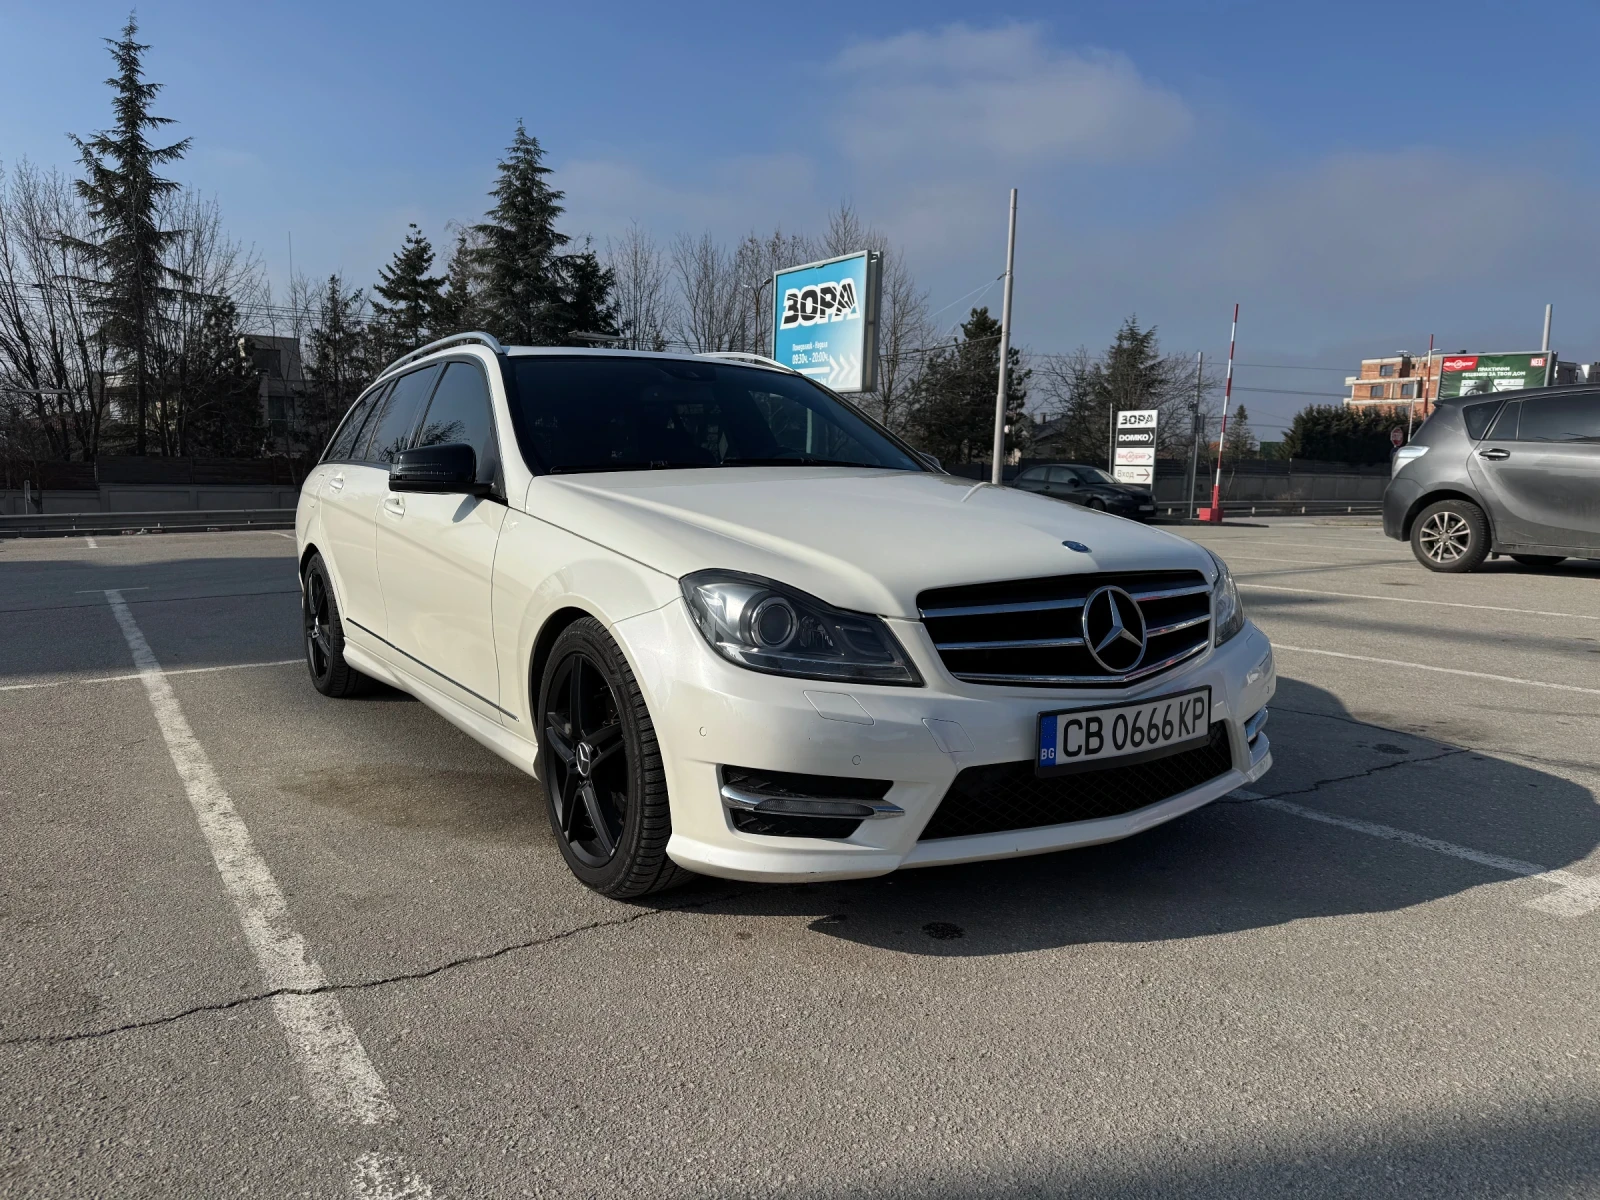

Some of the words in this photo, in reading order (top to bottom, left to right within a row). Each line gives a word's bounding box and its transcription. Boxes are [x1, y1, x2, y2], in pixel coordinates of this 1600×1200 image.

[781, 280, 858, 327] ЗОРА
[1120, 414, 1154, 425] ЗОРА
[1117, 469, 1134, 479] Вход
[1063, 716, 1104, 757] CB
[1112, 703, 1174, 750] 0666
[1178, 696, 1205, 738] KP
[1041, 747, 1055, 760] BG
